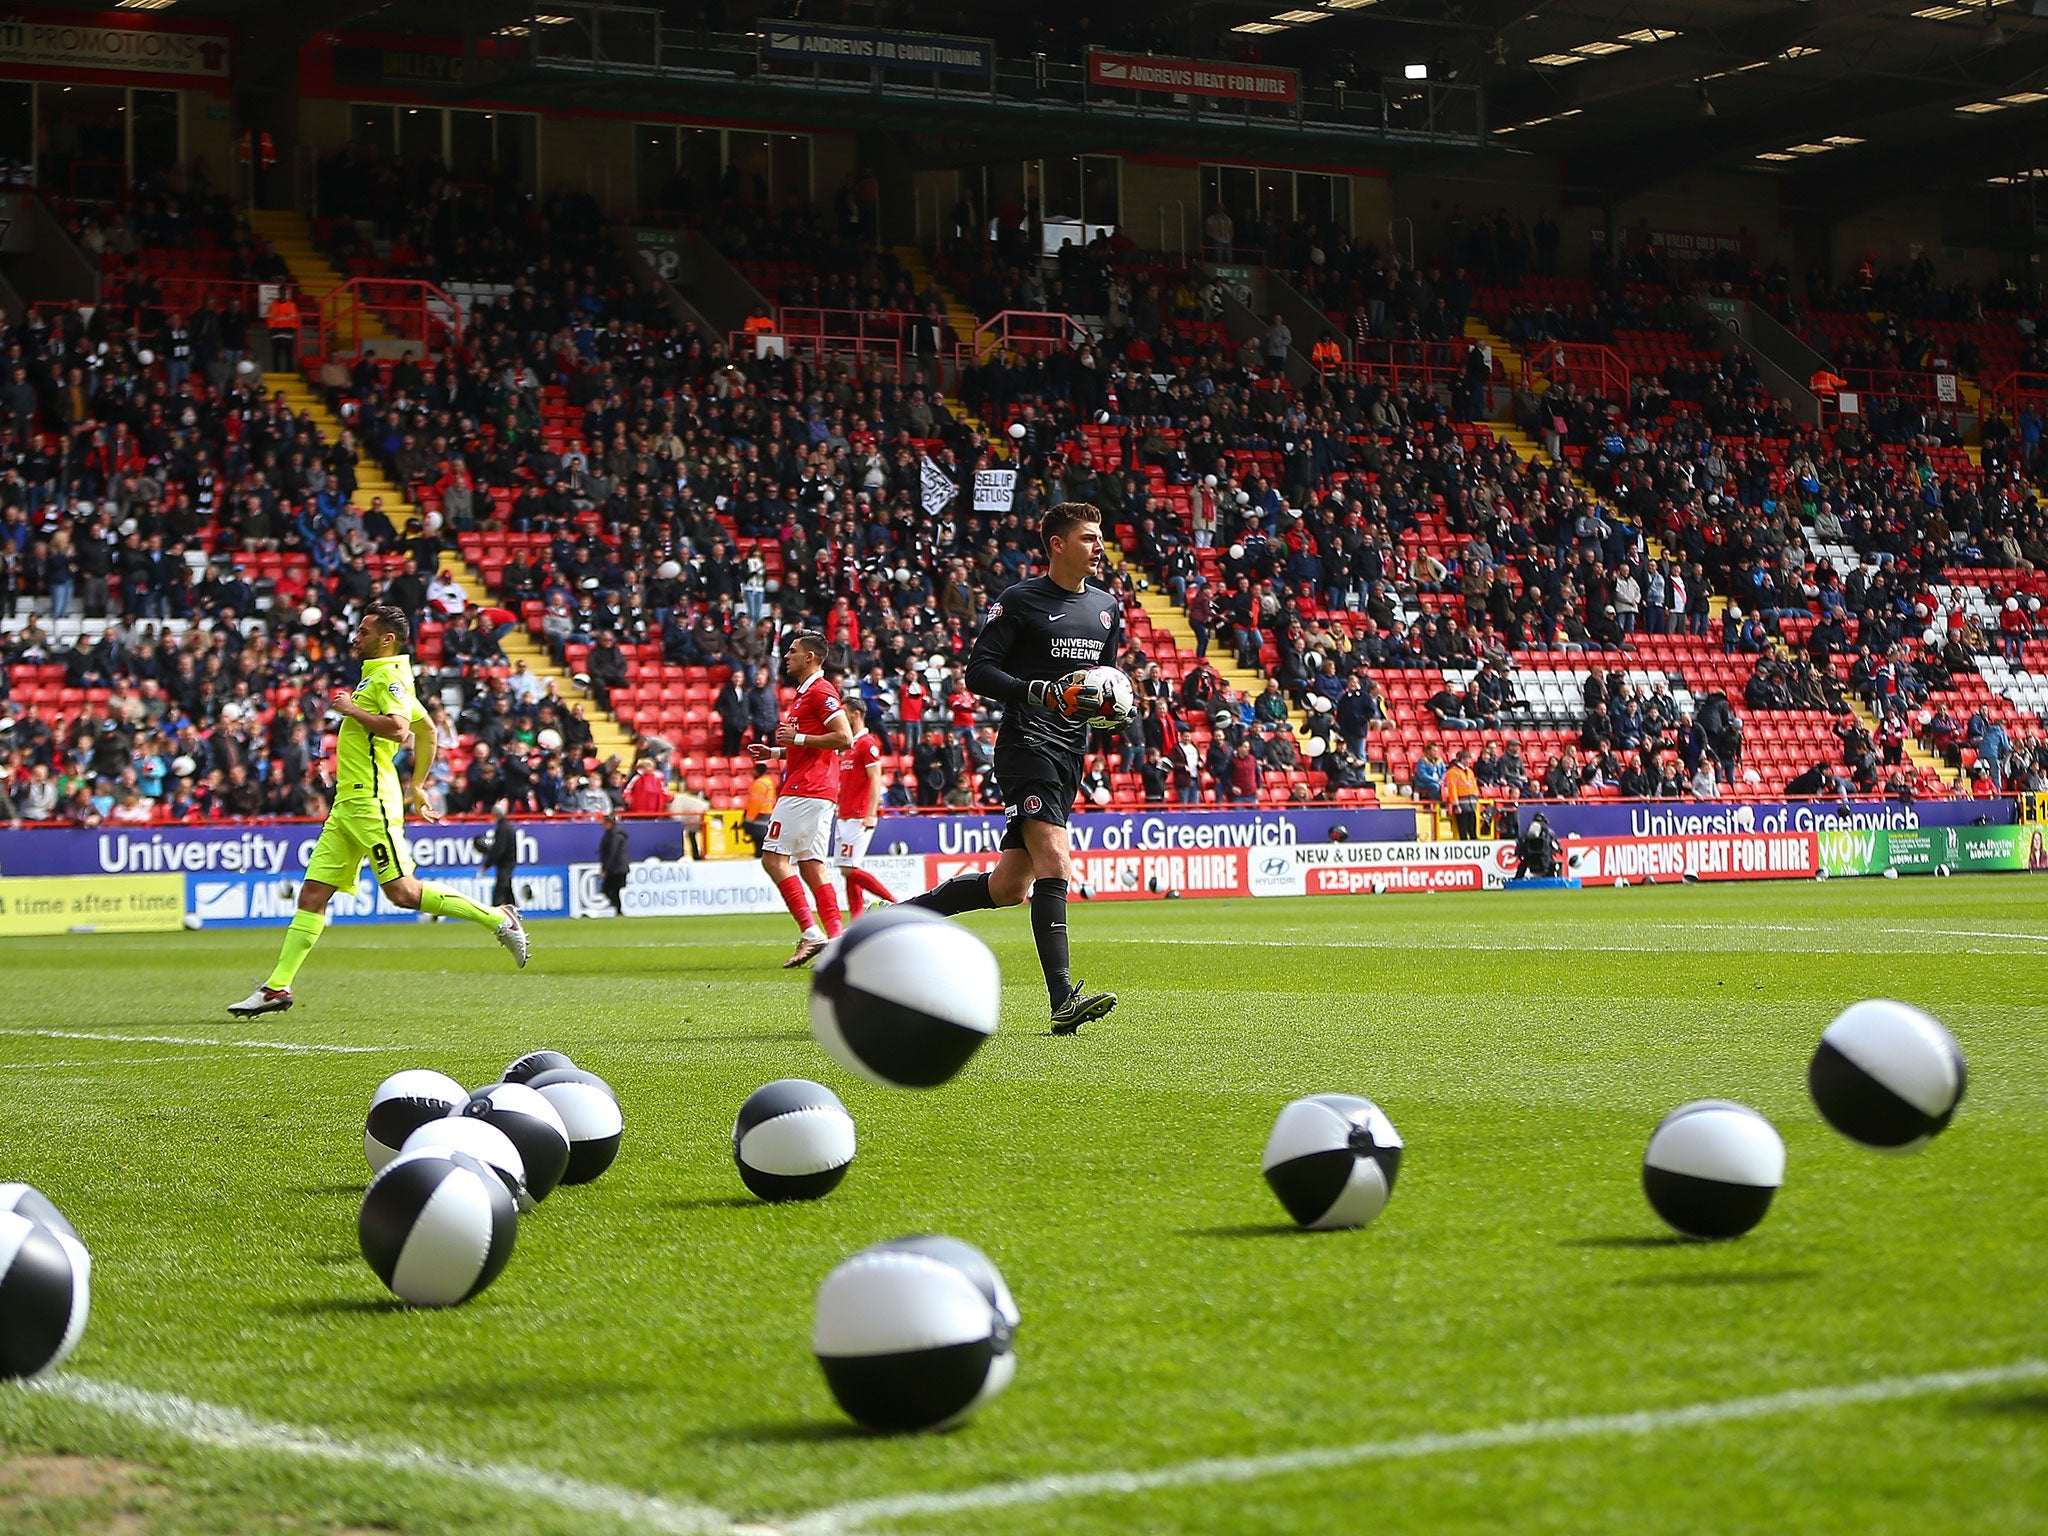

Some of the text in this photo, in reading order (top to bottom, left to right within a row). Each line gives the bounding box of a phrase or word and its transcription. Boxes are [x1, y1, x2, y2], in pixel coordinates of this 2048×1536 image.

[32, 28, 197, 59] PROMOTIONS
[802, 35, 981, 68] ANDREWS AIR CONDITIONING
[1129, 65, 1286, 95] ANDREWS HEAT FOR HIRE
[976, 473, 998, 487] SELL
[1051, 638, 1104, 651] UNIVERSITY
[1103, 817, 1133, 851] of
[1140, 813, 1299, 853] Greenwich
[1763, 806, 1788, 835] of
[1795, 806, 1920, 834] Greenwich
[98, 832, 290, 880] University
[372, 842, 389, 862] 9
[840, 843, 854, 858] 21
[1295, 845, 1491, 865] NEW & USED CARS IN SIDCUP
[1604, 837, 1810, 876] ANDREWS HEAT FOR HIRE
[1092, 856, 1140, 895] HEAT
[1144, 855, 1182, 893] FOR
[1187, 853, 1239, 893] HIRE
[1317, 867, 1474, 894] 123premier.com
[15, 896, 65, 915] time
[71, 892, 123, 913] after
[129, 891, 178, 911] time
[623, 886, 773, 909] CONSTRUCTION
